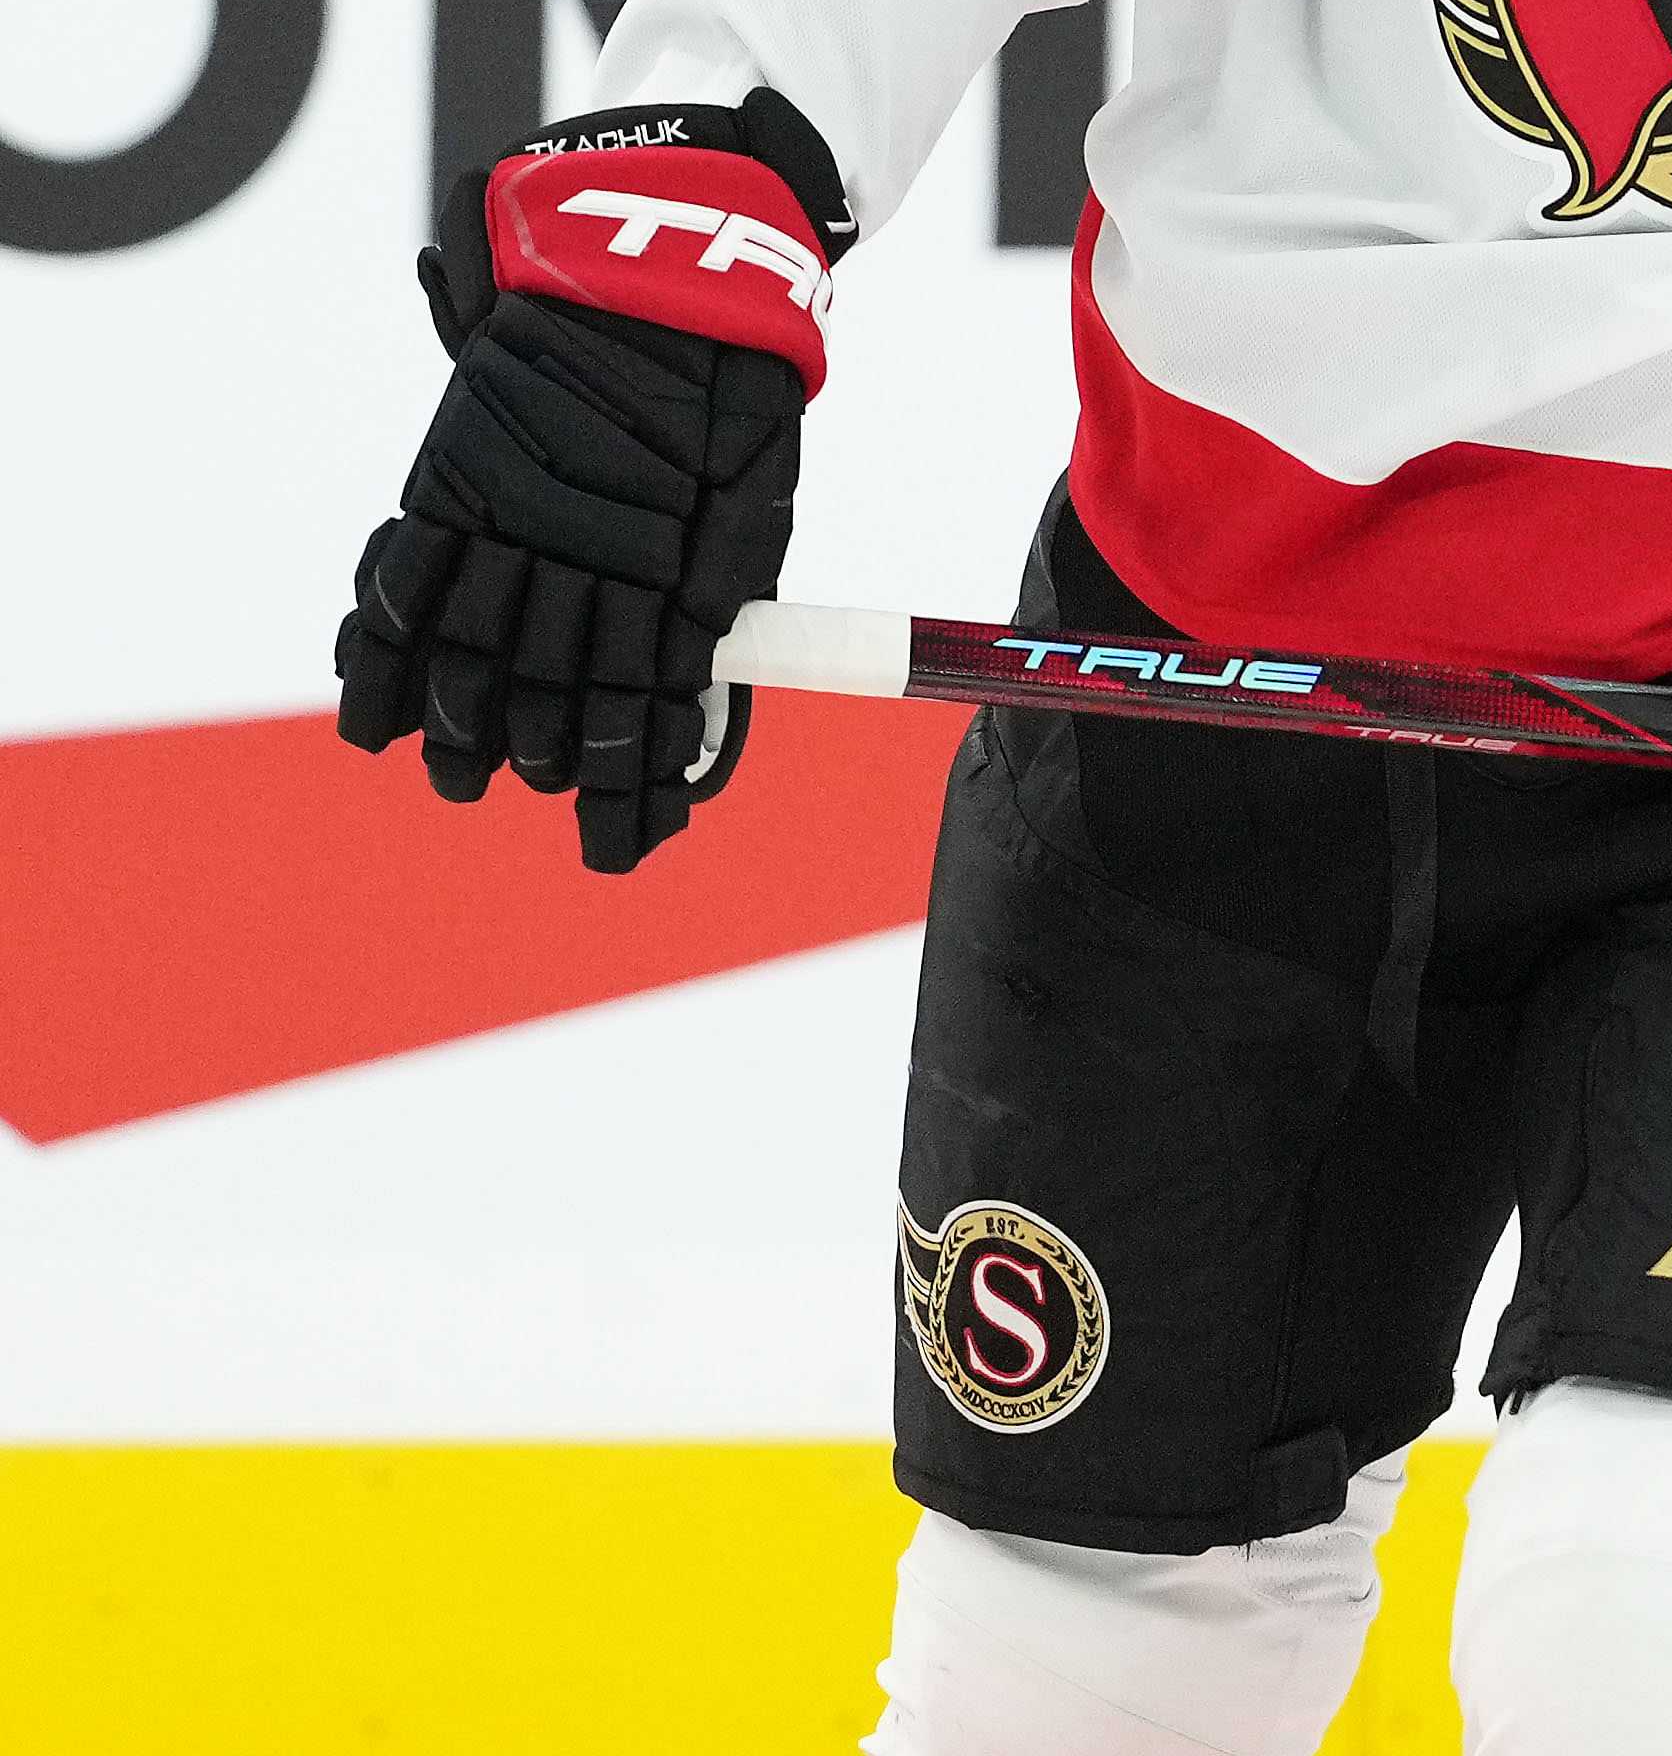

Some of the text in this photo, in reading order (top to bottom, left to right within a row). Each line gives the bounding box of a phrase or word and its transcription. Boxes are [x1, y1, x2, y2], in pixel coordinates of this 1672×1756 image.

[525, 117, 691, 156] TKACHUK
[993, 637, 1323, 694] TRUE
[1344, 725, 1518, 753] TRUE
[984, 1216, 1026, 1240] EST.
[964, 1252, 1049, 1387] S
